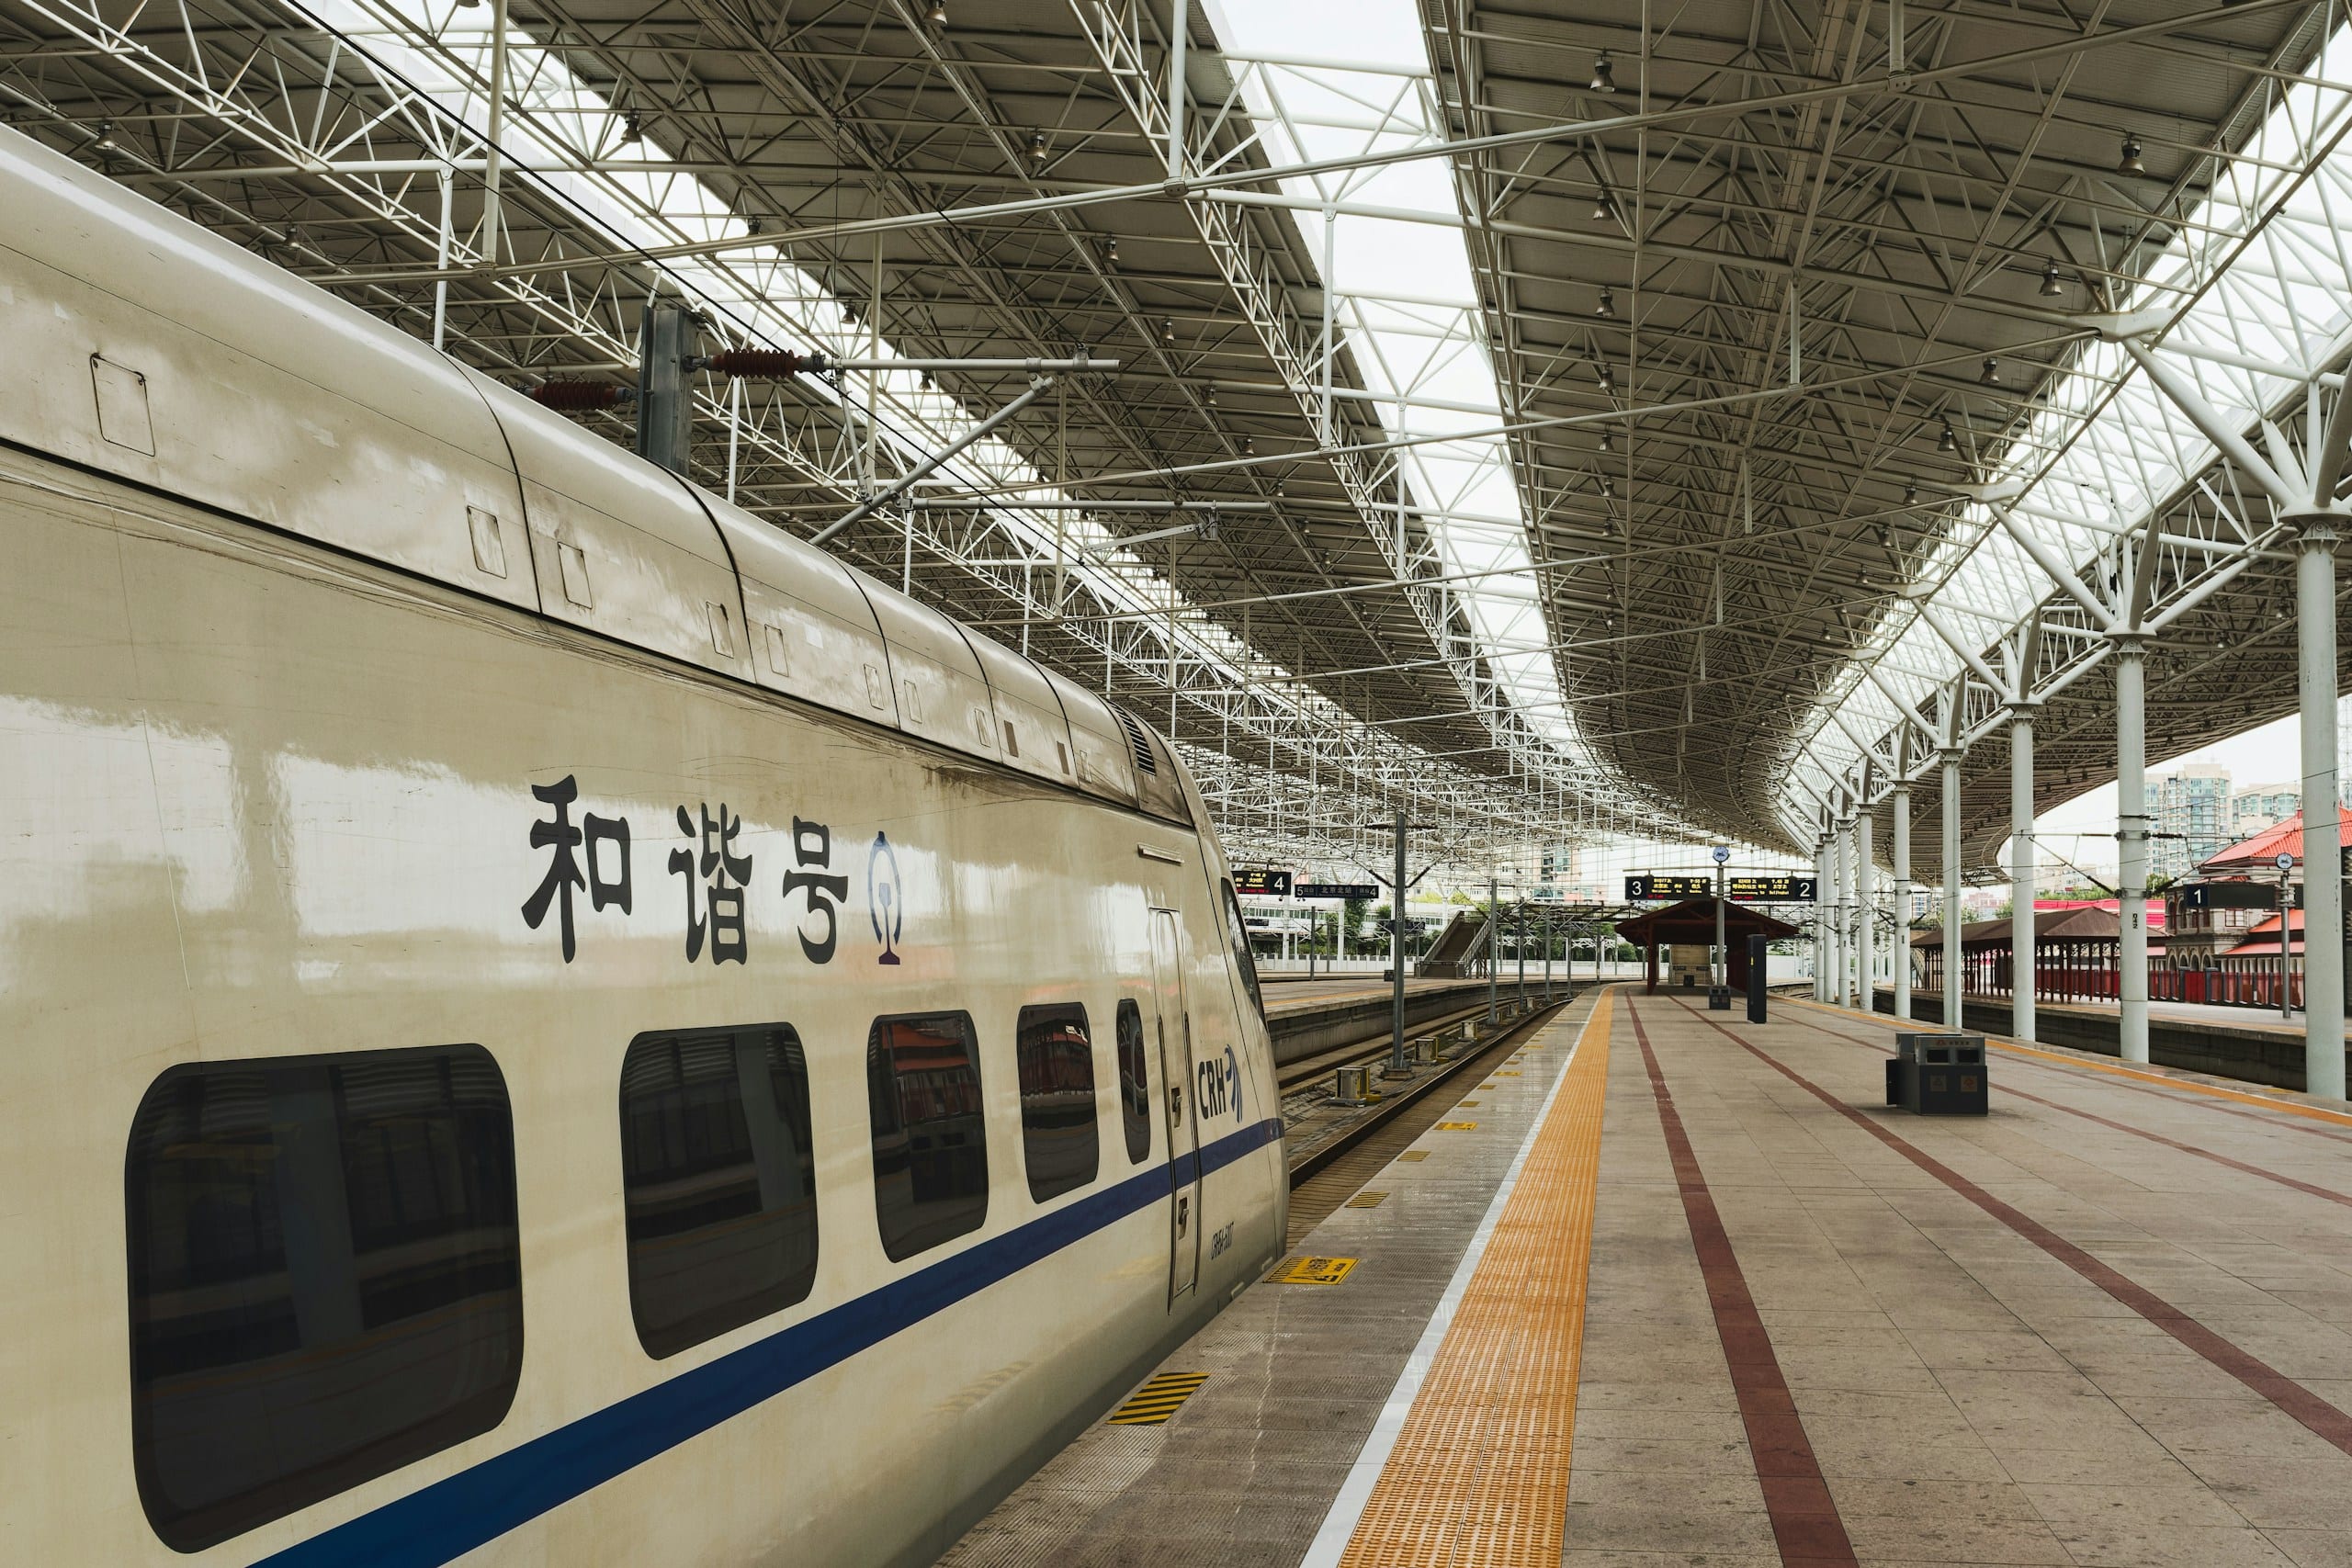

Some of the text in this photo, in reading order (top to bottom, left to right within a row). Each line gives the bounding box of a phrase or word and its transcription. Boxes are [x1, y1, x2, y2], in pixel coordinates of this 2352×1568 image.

[521, 774, 849, 965] 和谐号
[1273, 876, 1284, 890] 4
[1632, 881, 1642, 896] 3
[1799, 882, 1810, 897] 2
[1296, 886, 1304, 896] 5
[1369, 887, 1376, 897] 4
[2194, 889, 2201, 904] 1
[1198, 1057, 1227, 1120] CRH
